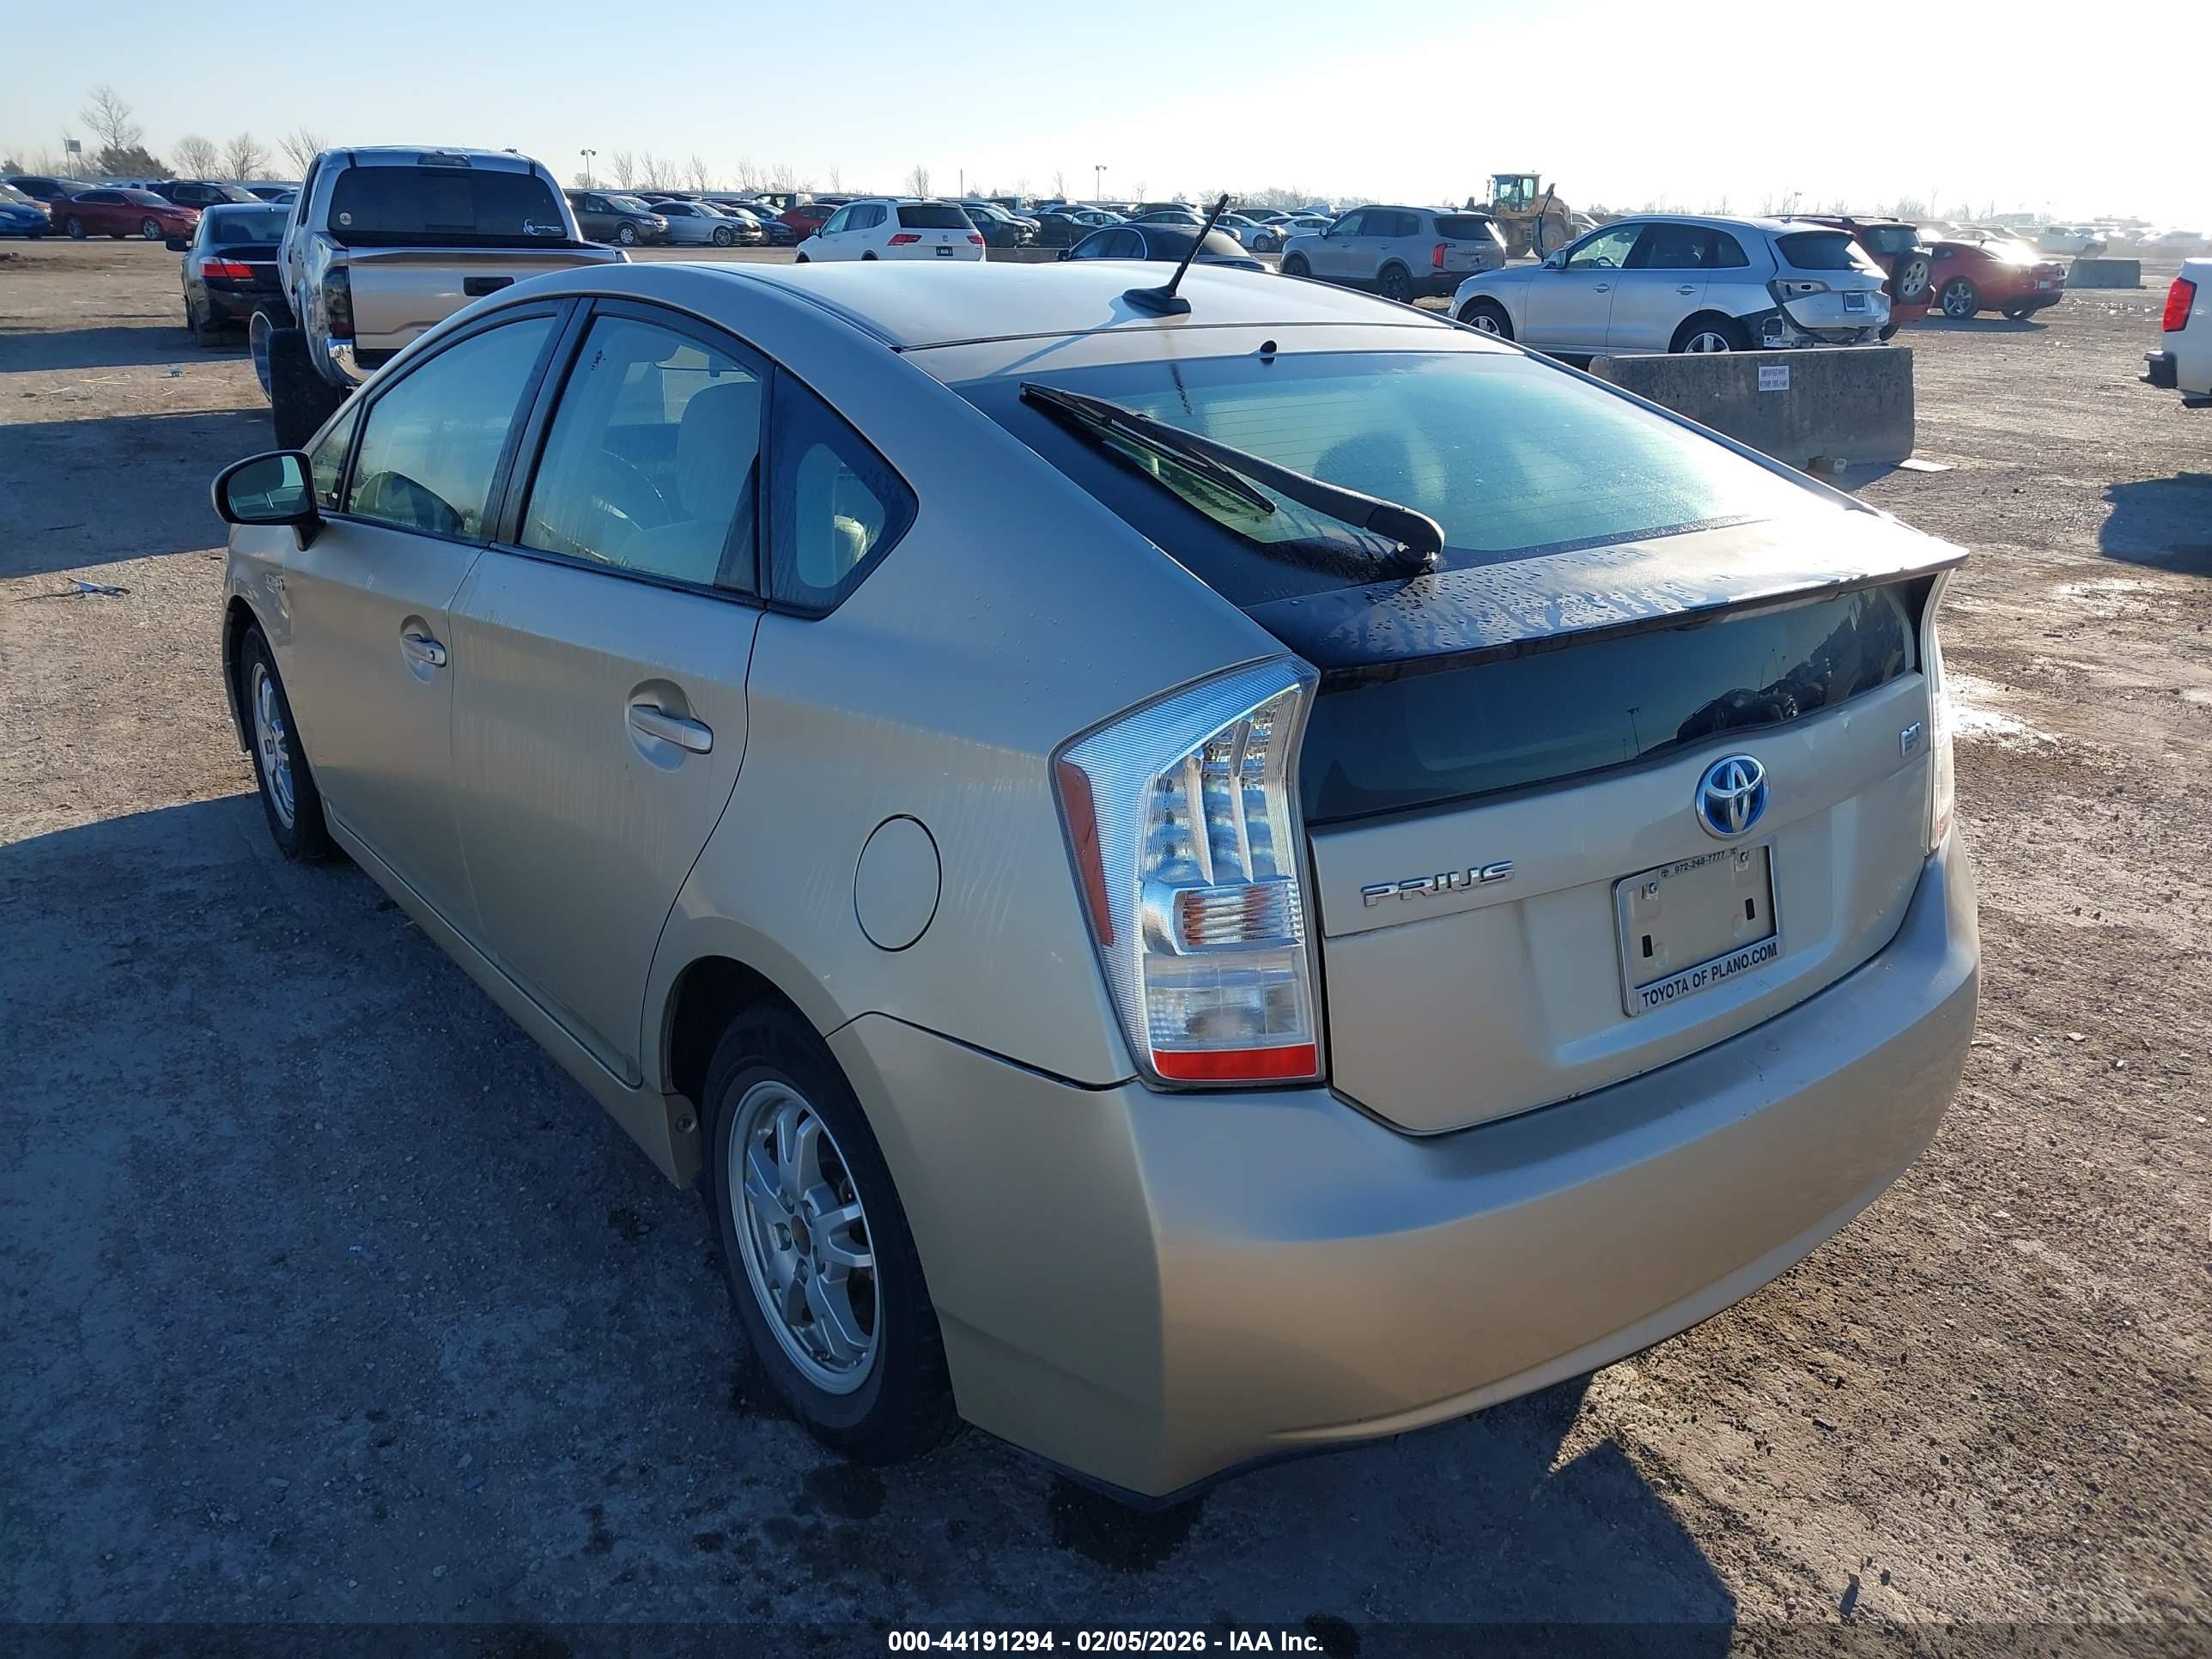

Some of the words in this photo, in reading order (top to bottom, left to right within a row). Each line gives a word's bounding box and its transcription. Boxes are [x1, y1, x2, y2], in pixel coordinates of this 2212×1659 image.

[1360, 860, 1515, 907] PRIUS
[1642, 978, 1689, 1008] TOYOTA
[1692, 969, 1707, 988] OF
[1711, 942, 1778, 981] PLANO.COM
